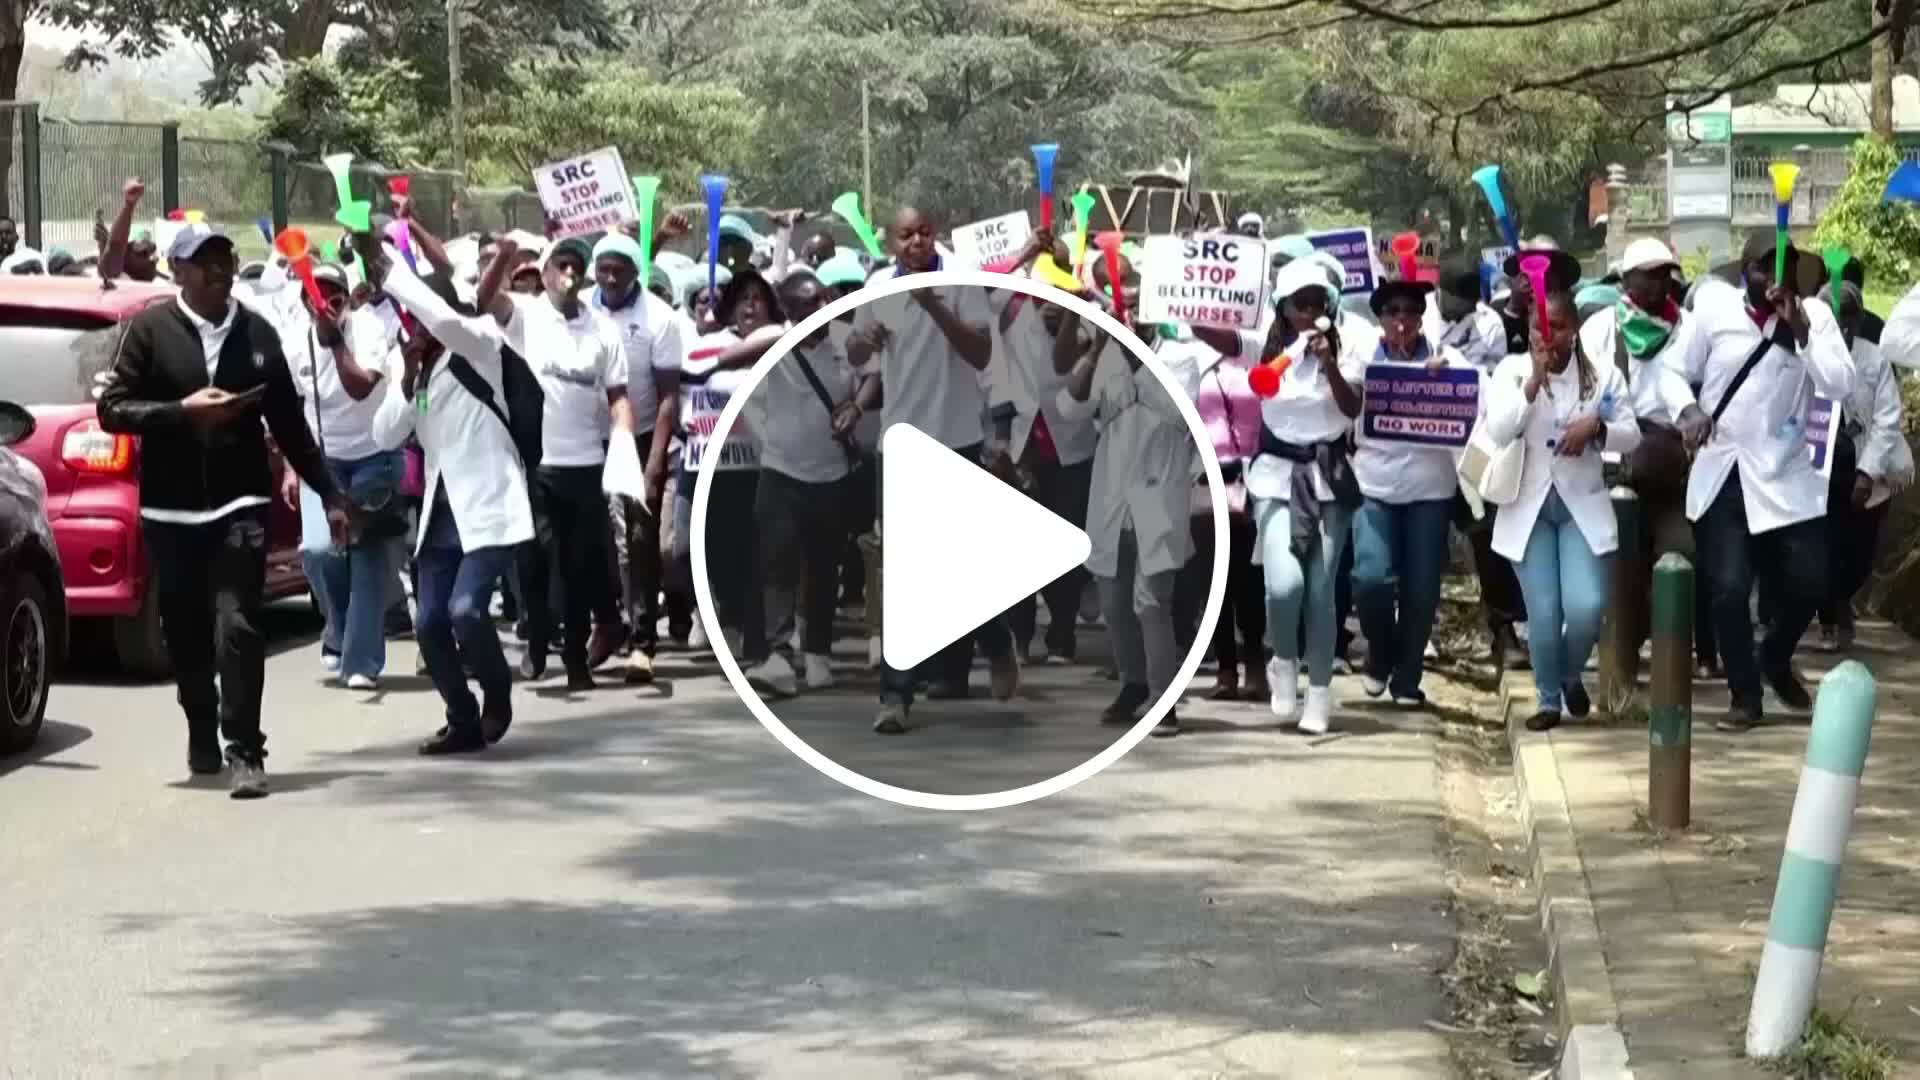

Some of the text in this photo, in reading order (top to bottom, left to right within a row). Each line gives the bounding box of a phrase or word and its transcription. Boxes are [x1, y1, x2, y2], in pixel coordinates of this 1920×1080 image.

[551, 161, 596, 187] SRC
[561, 181, 599, 204] STOP
[552, 192, 623, 219] BELITTLING
[976, 222, 1008, 241] SRC
[1183, 240, 1239, 263] SRC
[1183, 265, 1237, 285] STOP
[1158, 284, 1256, 306] BELITTLING
[1168, 304, 1244, 326] NURSES
[1377, 418, 1462, 435] NO WORK
